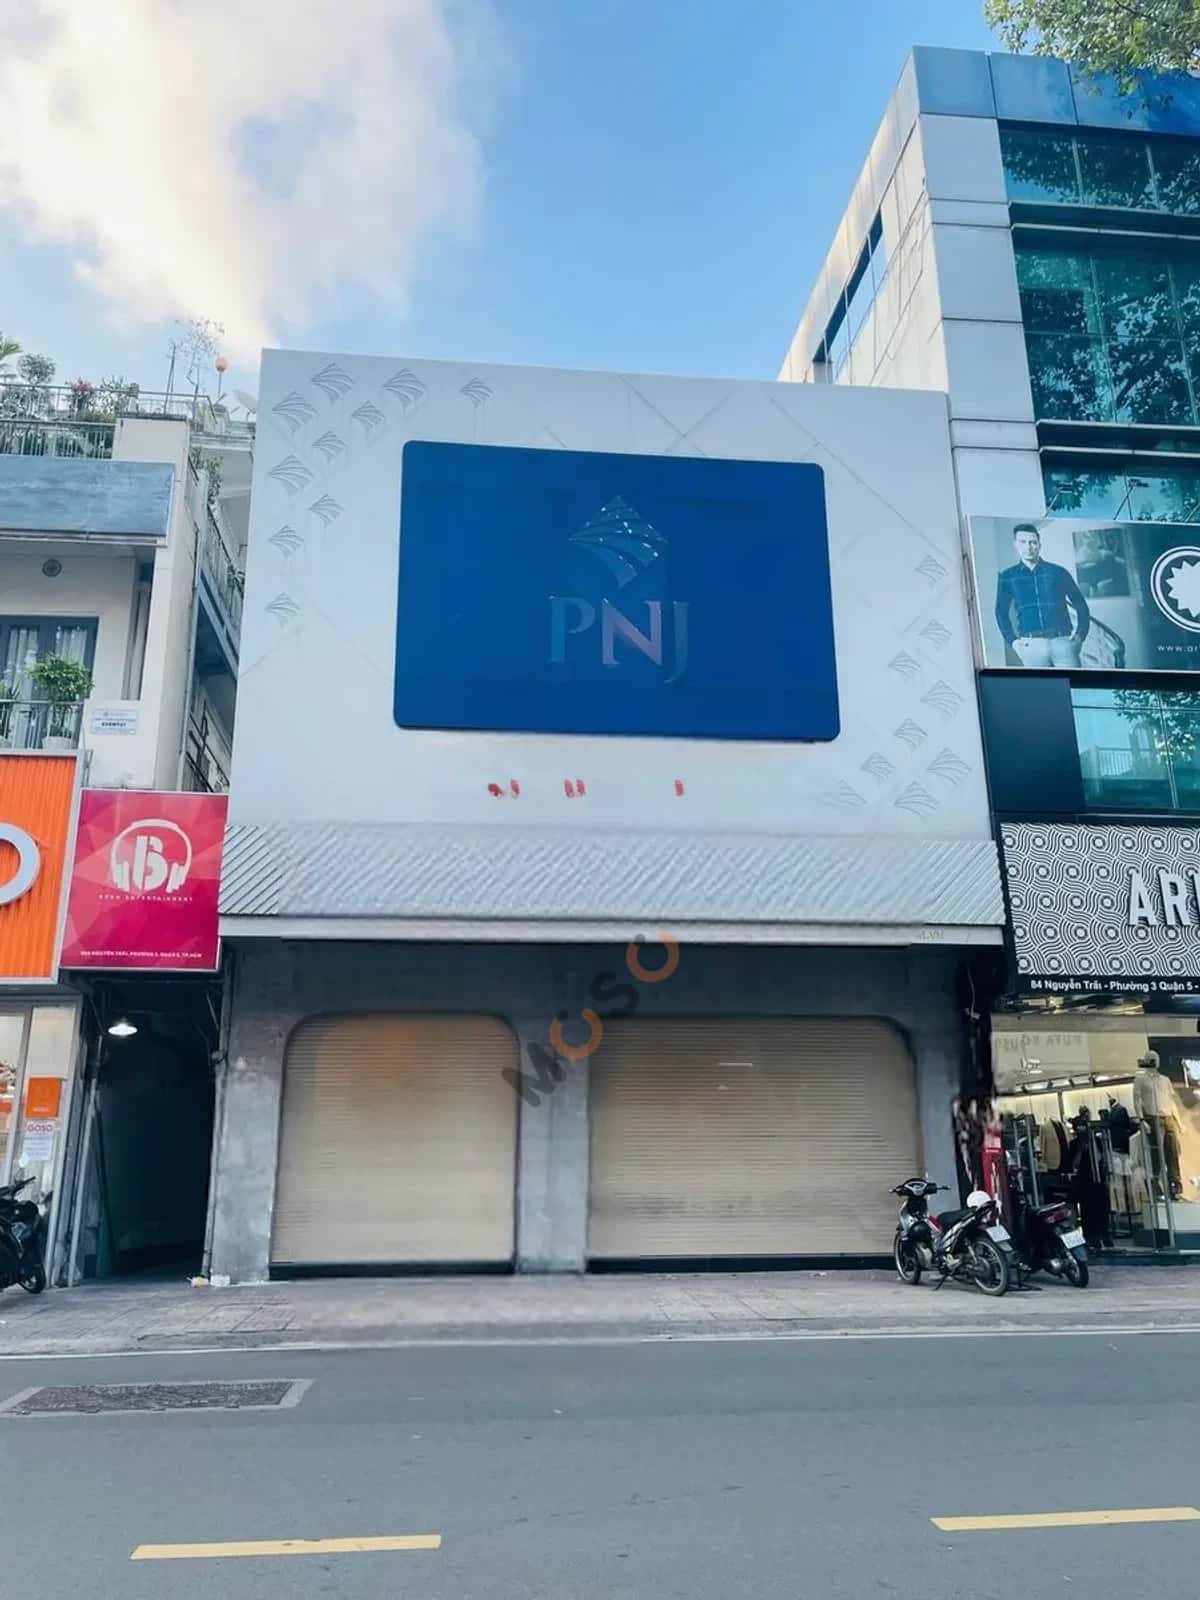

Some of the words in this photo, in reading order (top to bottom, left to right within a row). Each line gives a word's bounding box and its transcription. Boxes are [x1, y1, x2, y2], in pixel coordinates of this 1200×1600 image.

[547, 594, 690, 685] PNJ
[1109, 980, 1149, 993] Phường
[1150, 981, 1157, 991] 3
[1159, 981, 1185, 993] Quận
[1186, 981, 1193, 991] 5
